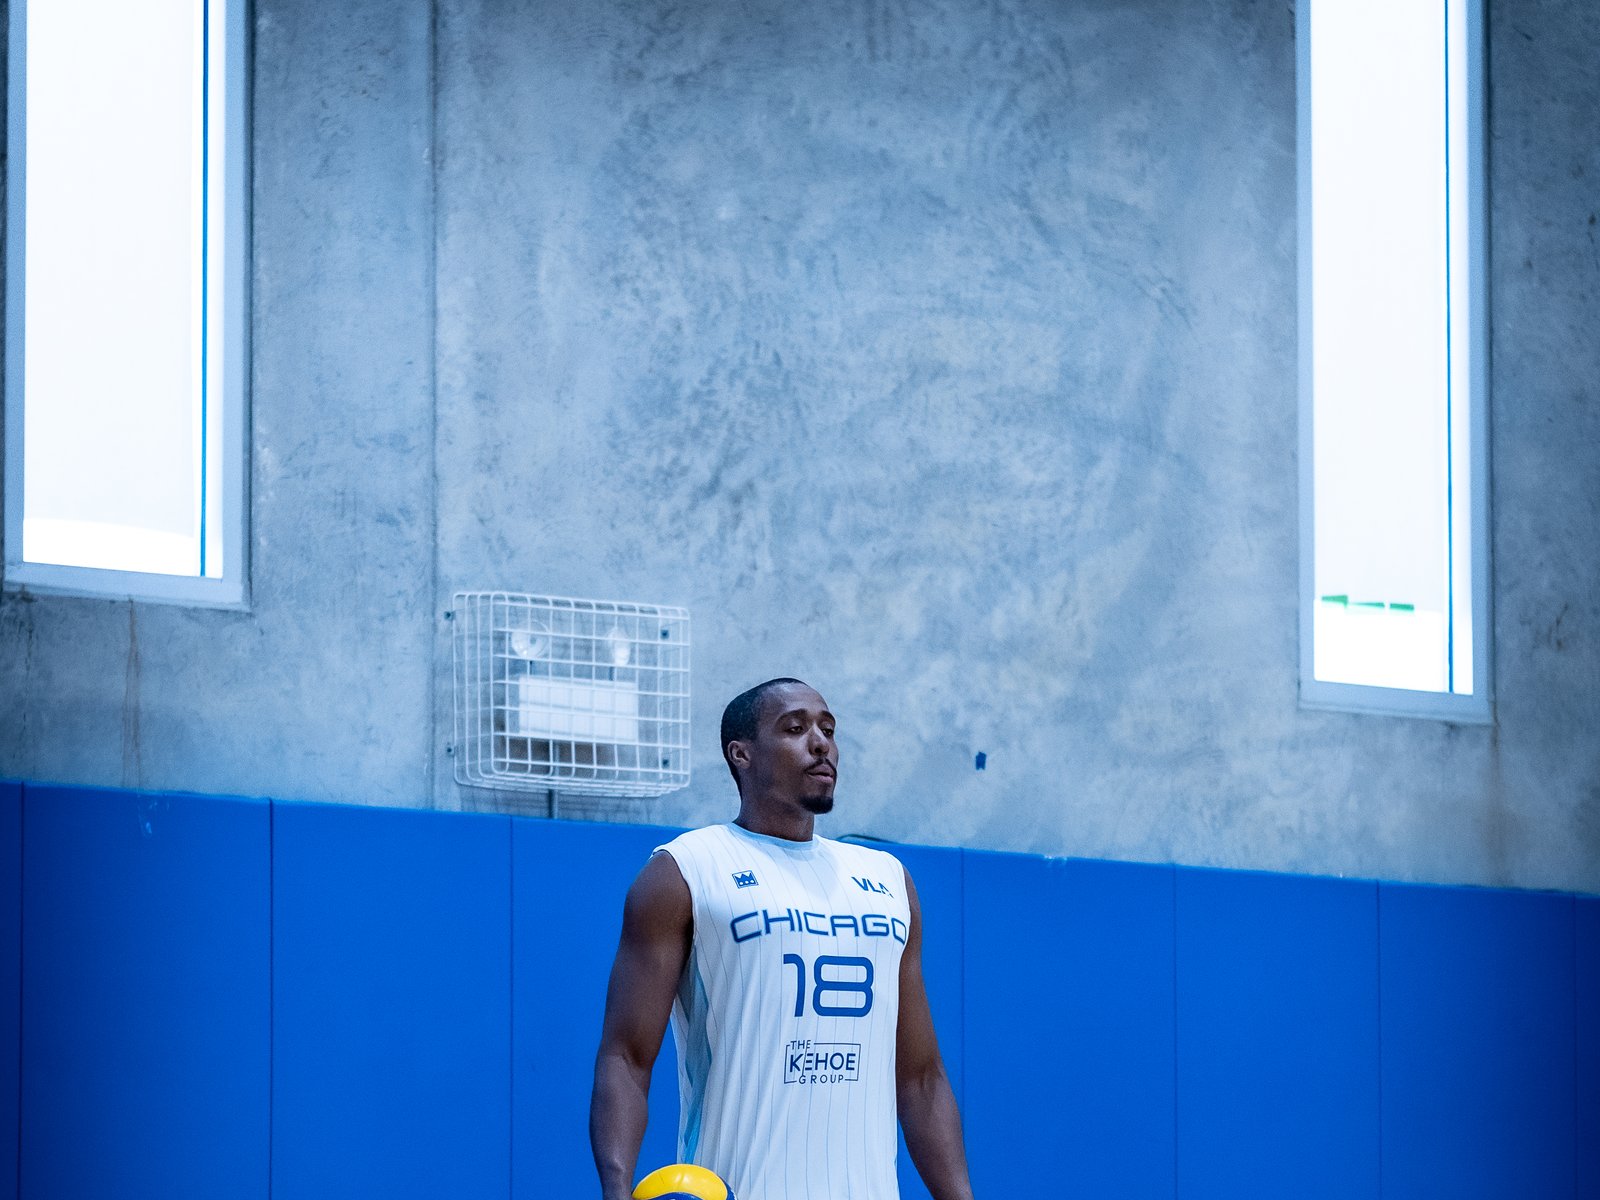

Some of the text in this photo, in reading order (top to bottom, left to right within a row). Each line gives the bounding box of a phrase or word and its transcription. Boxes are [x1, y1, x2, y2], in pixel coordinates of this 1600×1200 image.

[730, 908, 907, 944] CHICAGO
[783, 953, 874, 1018] 18
[790, 1040, 811, 1050] THE
[789, 1052, 856, 1073] KEHOE
[798, 1074, 844, 1085] GROUP
